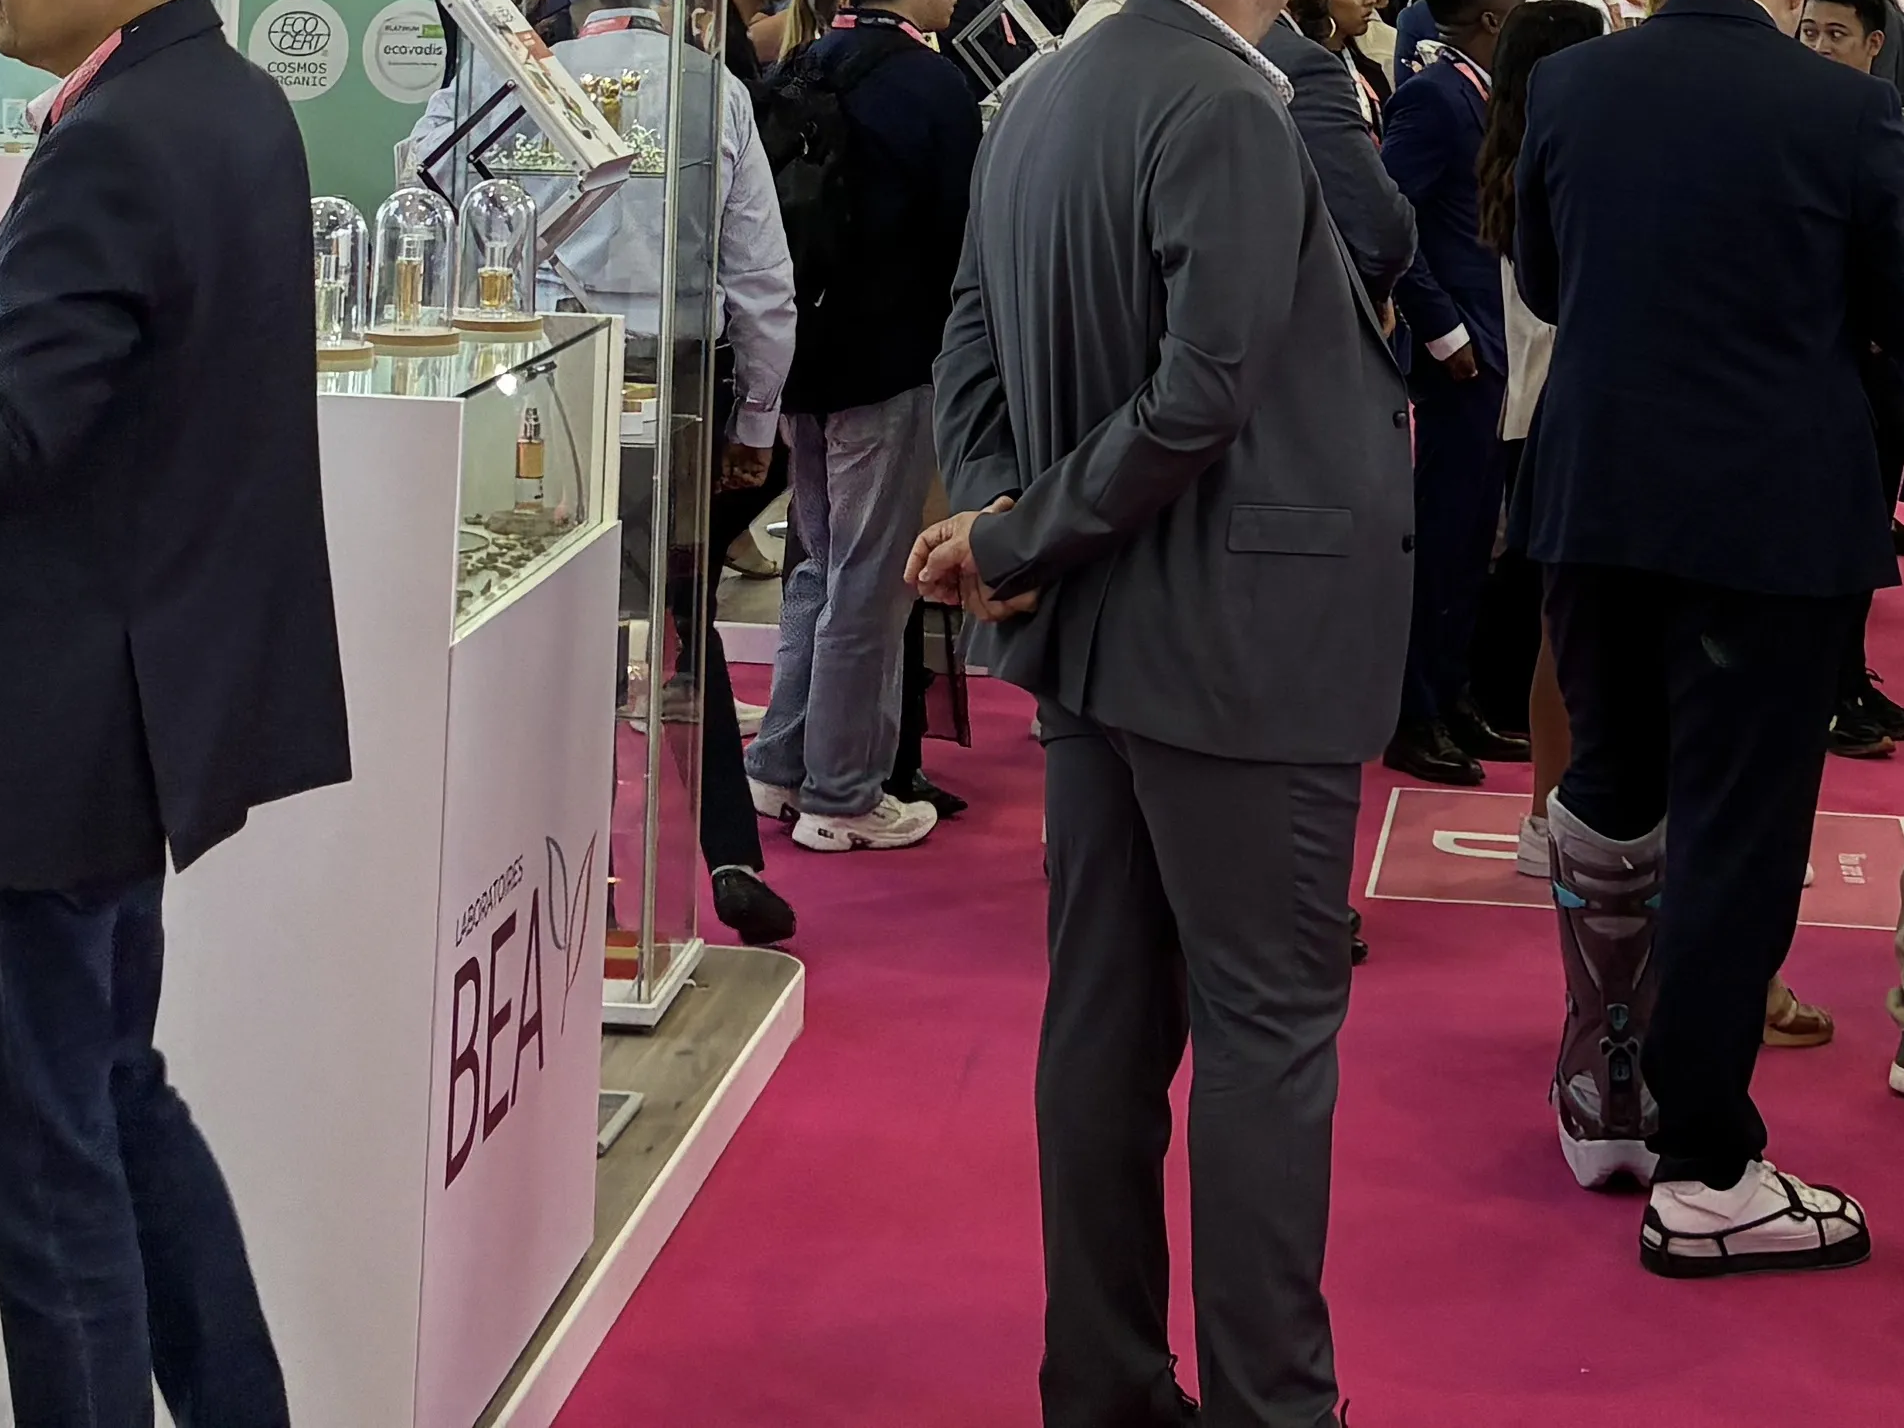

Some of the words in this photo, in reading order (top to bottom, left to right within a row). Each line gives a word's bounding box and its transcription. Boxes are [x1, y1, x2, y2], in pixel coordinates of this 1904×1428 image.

[283, 16, 318, 32] ECO
[279, 34, 322, 51] CERT
[384, 44, 443, 57] ecovadis
[268, 62, 327, 74] COSMOS
[276, 76, 327, 87] RGANIC
[444, 885, 545, 1190] BEA
